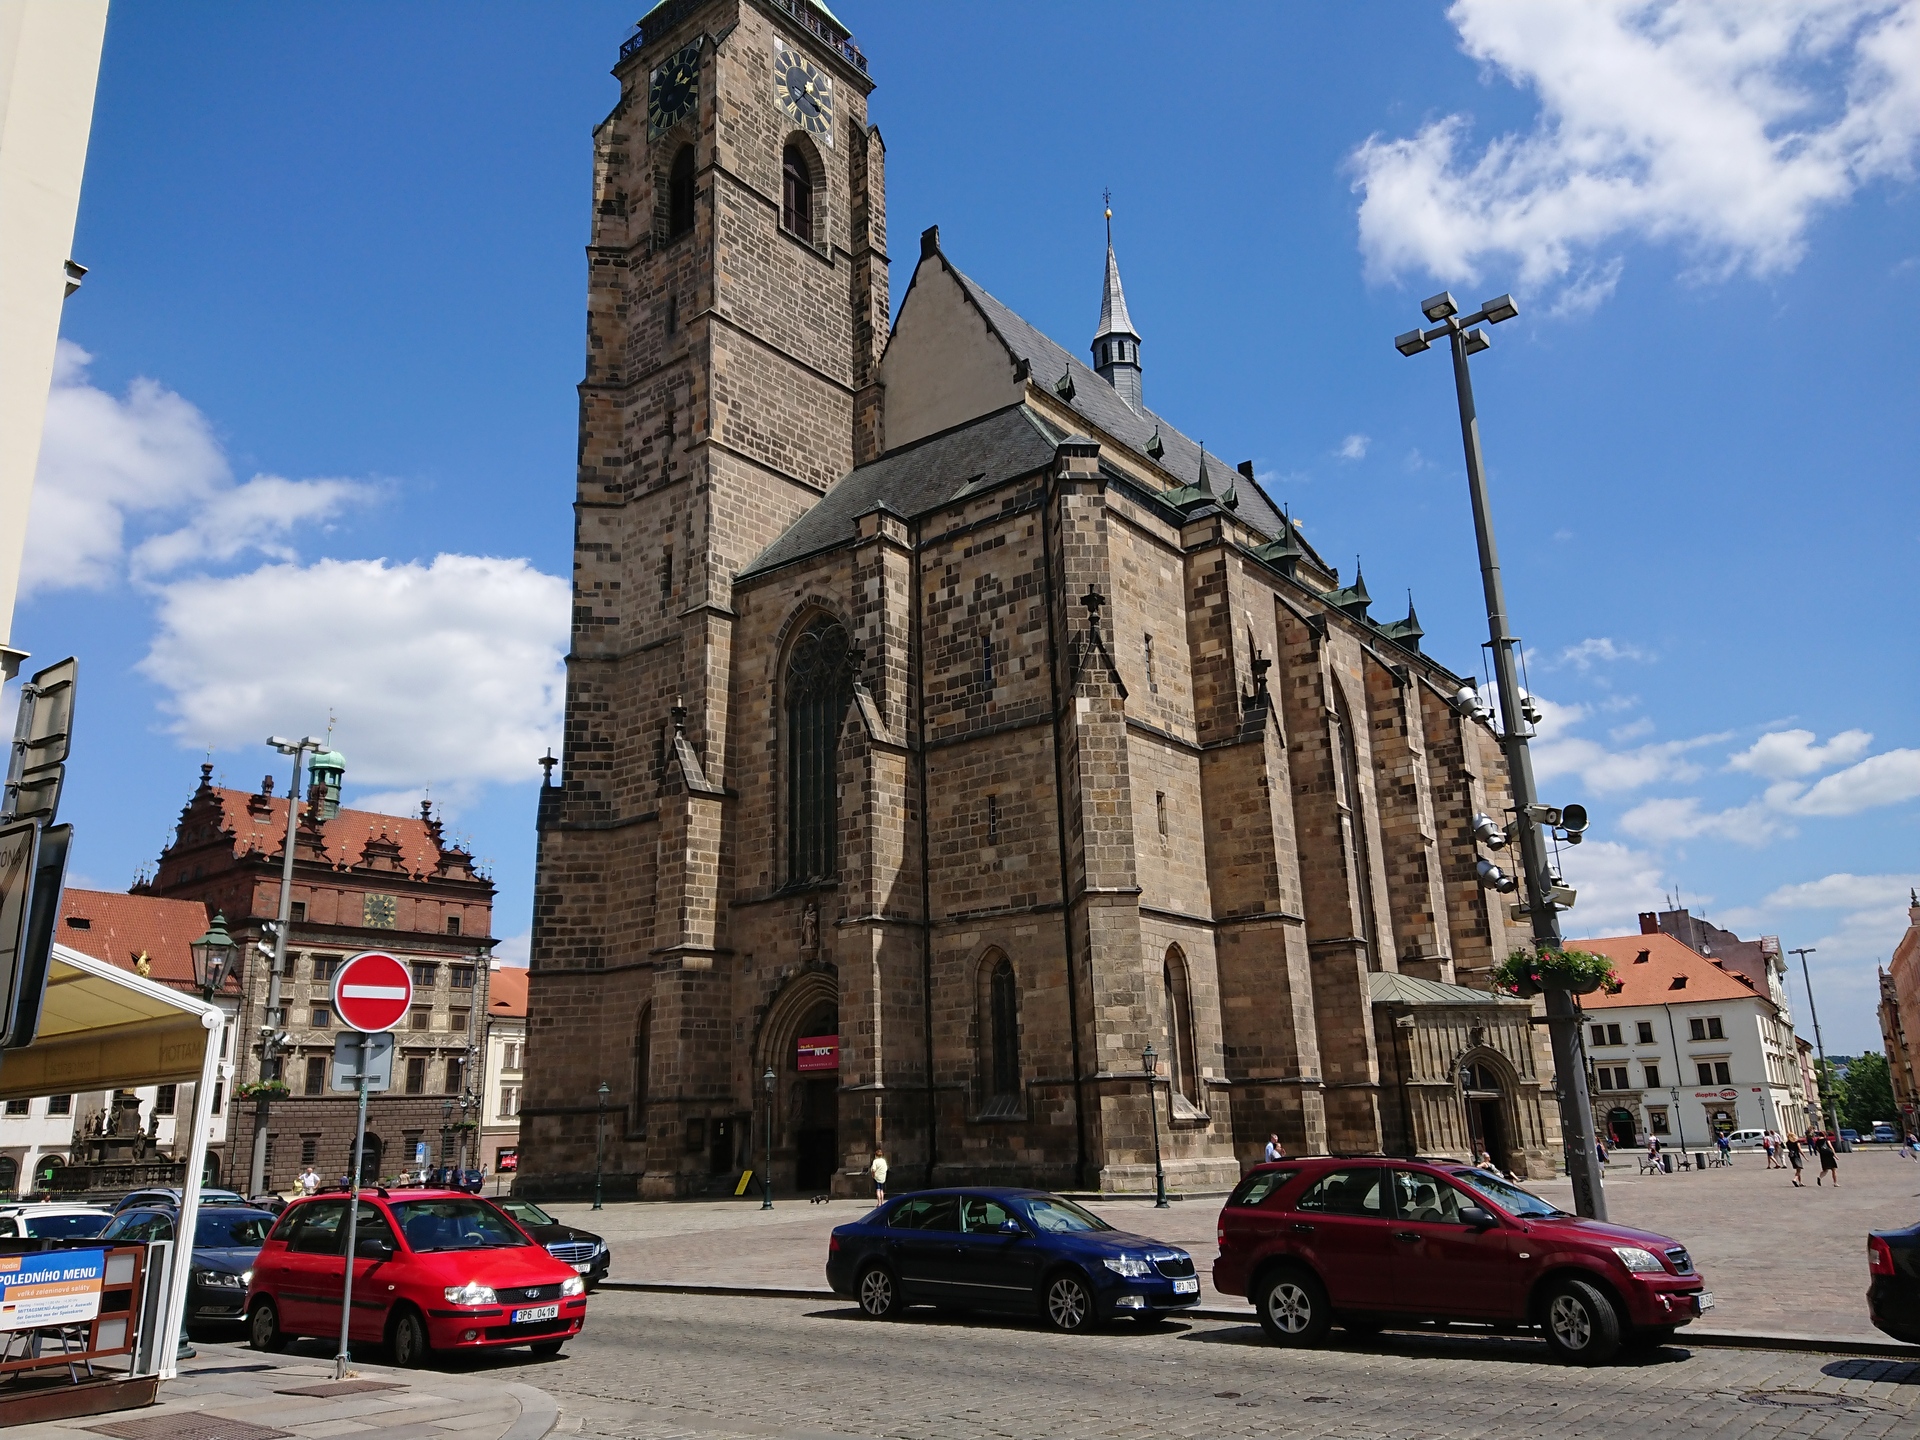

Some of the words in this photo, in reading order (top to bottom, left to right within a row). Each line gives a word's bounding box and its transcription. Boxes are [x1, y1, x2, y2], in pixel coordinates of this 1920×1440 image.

[0, 846, 22, 868] ÓNA
[63, 1267, 96, 1280] MENU
[71, 1284, 91, 1293] saláty
[518, 1310, 532, 1321] 3P6
[537, 1307, 555, 1318] 0418
